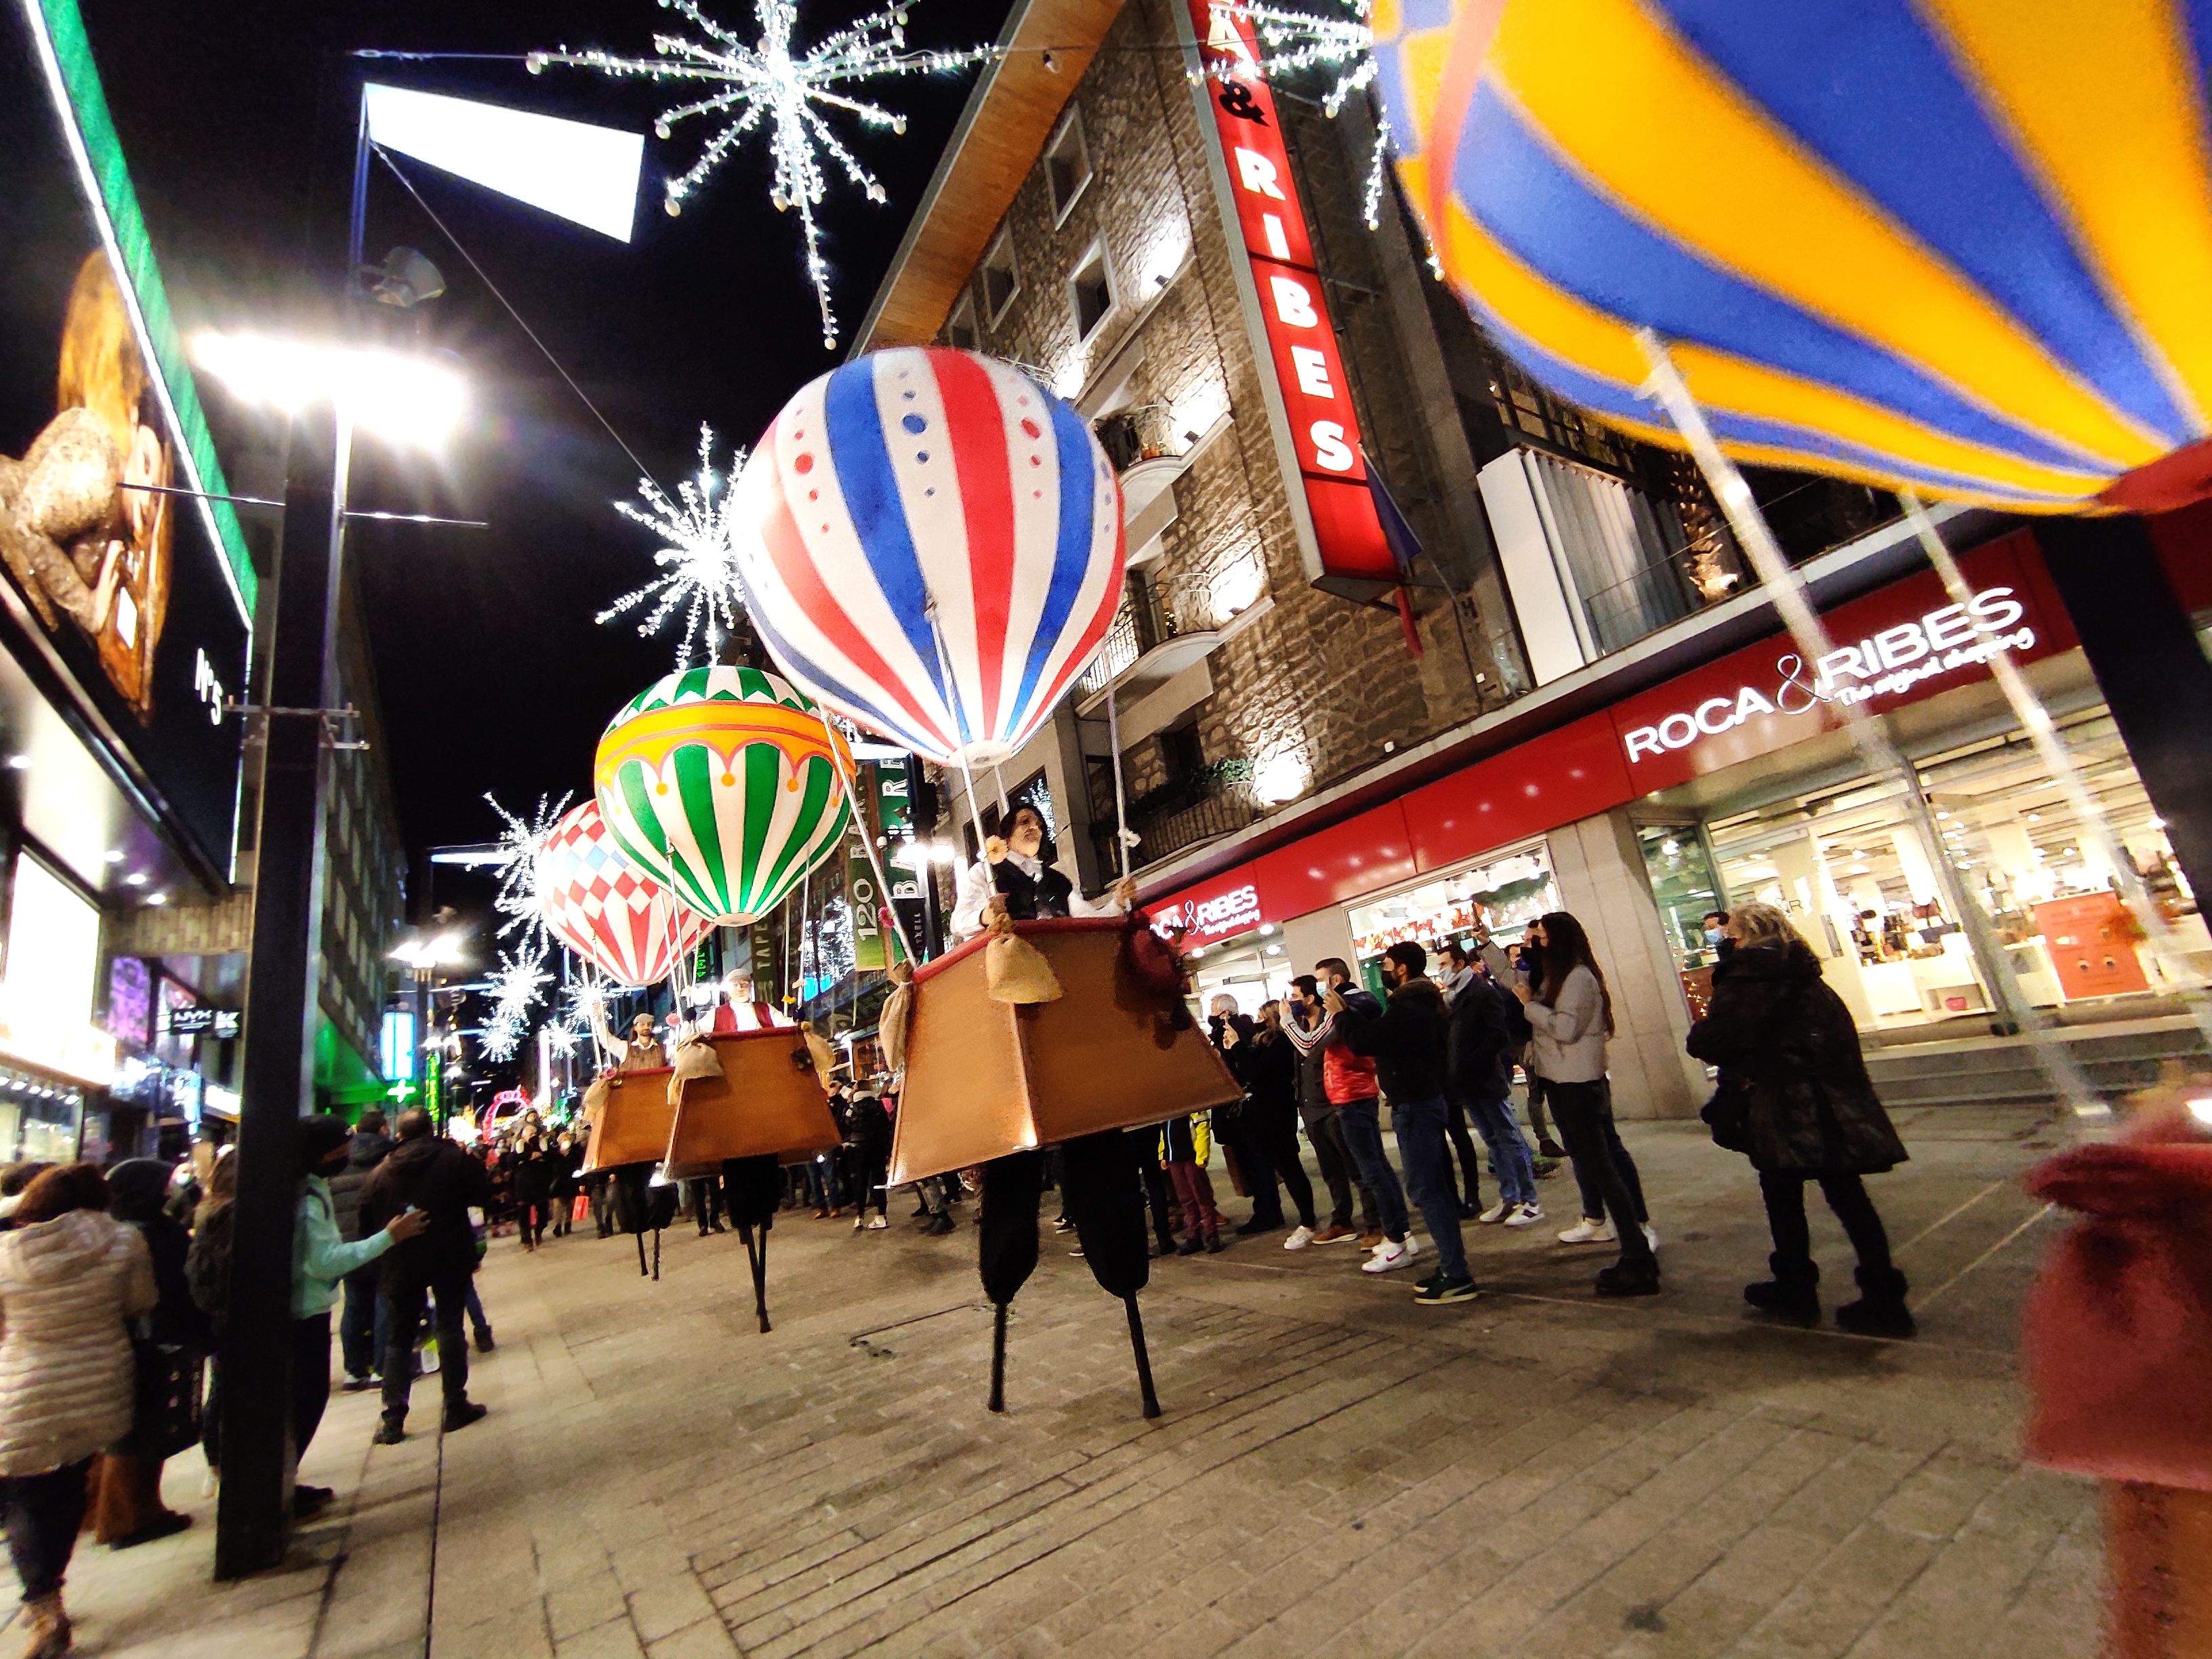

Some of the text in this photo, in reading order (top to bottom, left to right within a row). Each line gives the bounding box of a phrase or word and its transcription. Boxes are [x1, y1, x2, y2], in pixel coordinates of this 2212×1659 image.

[1218, 79, 1270, 127] &
[1235, 147, 1354, 472] RIBES
[1624, 586, 2023, 764] ROCA & RIBES
[853, 878, 879, 941] 120
[1185, 899, 1204, 936] &
[1197, 885, 1258, 926] RIBES
